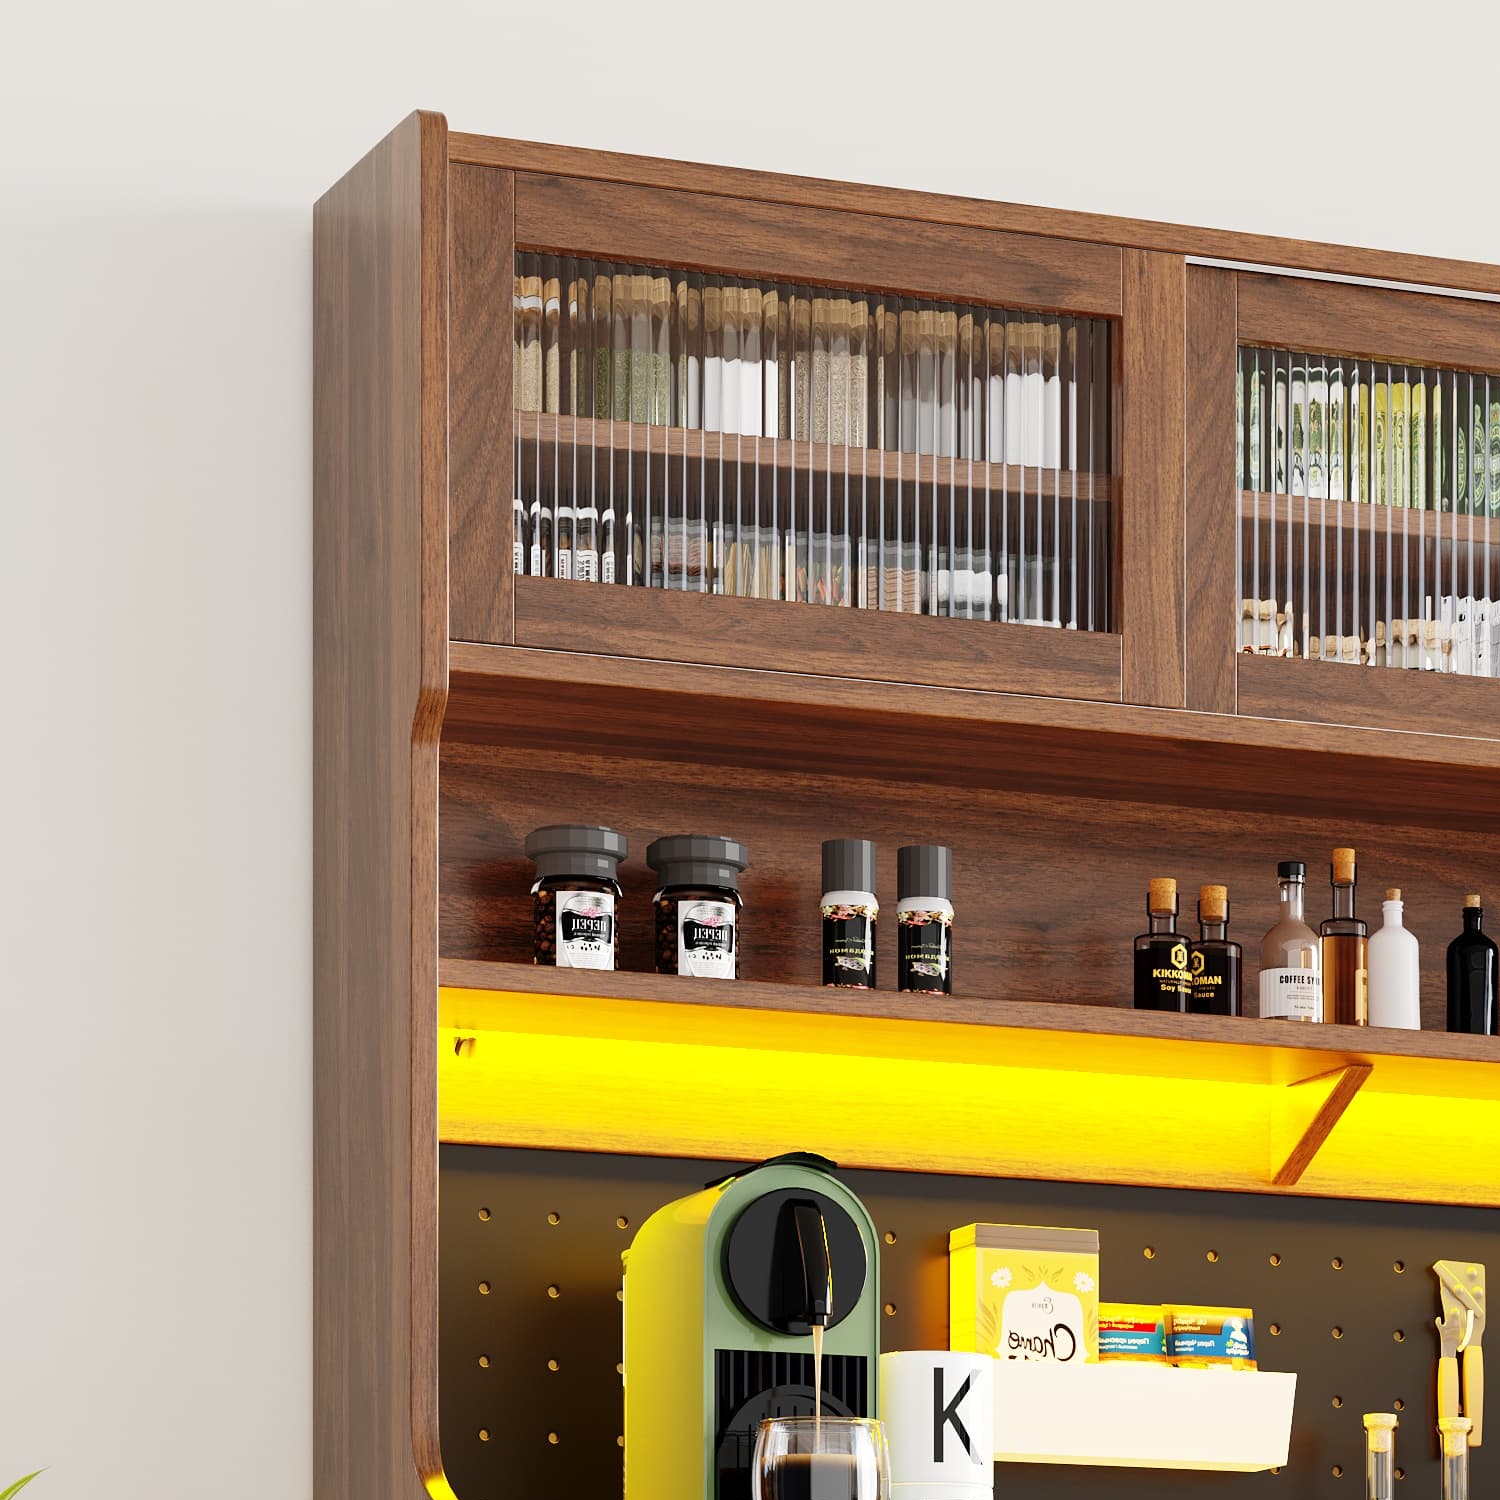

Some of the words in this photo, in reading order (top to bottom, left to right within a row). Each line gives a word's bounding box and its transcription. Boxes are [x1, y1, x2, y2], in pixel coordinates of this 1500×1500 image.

[1279, 975, 1305, 984] COFFEE
[1160, 984, 1176, 993] Soy
[933, 1367, 983, 1466] K
